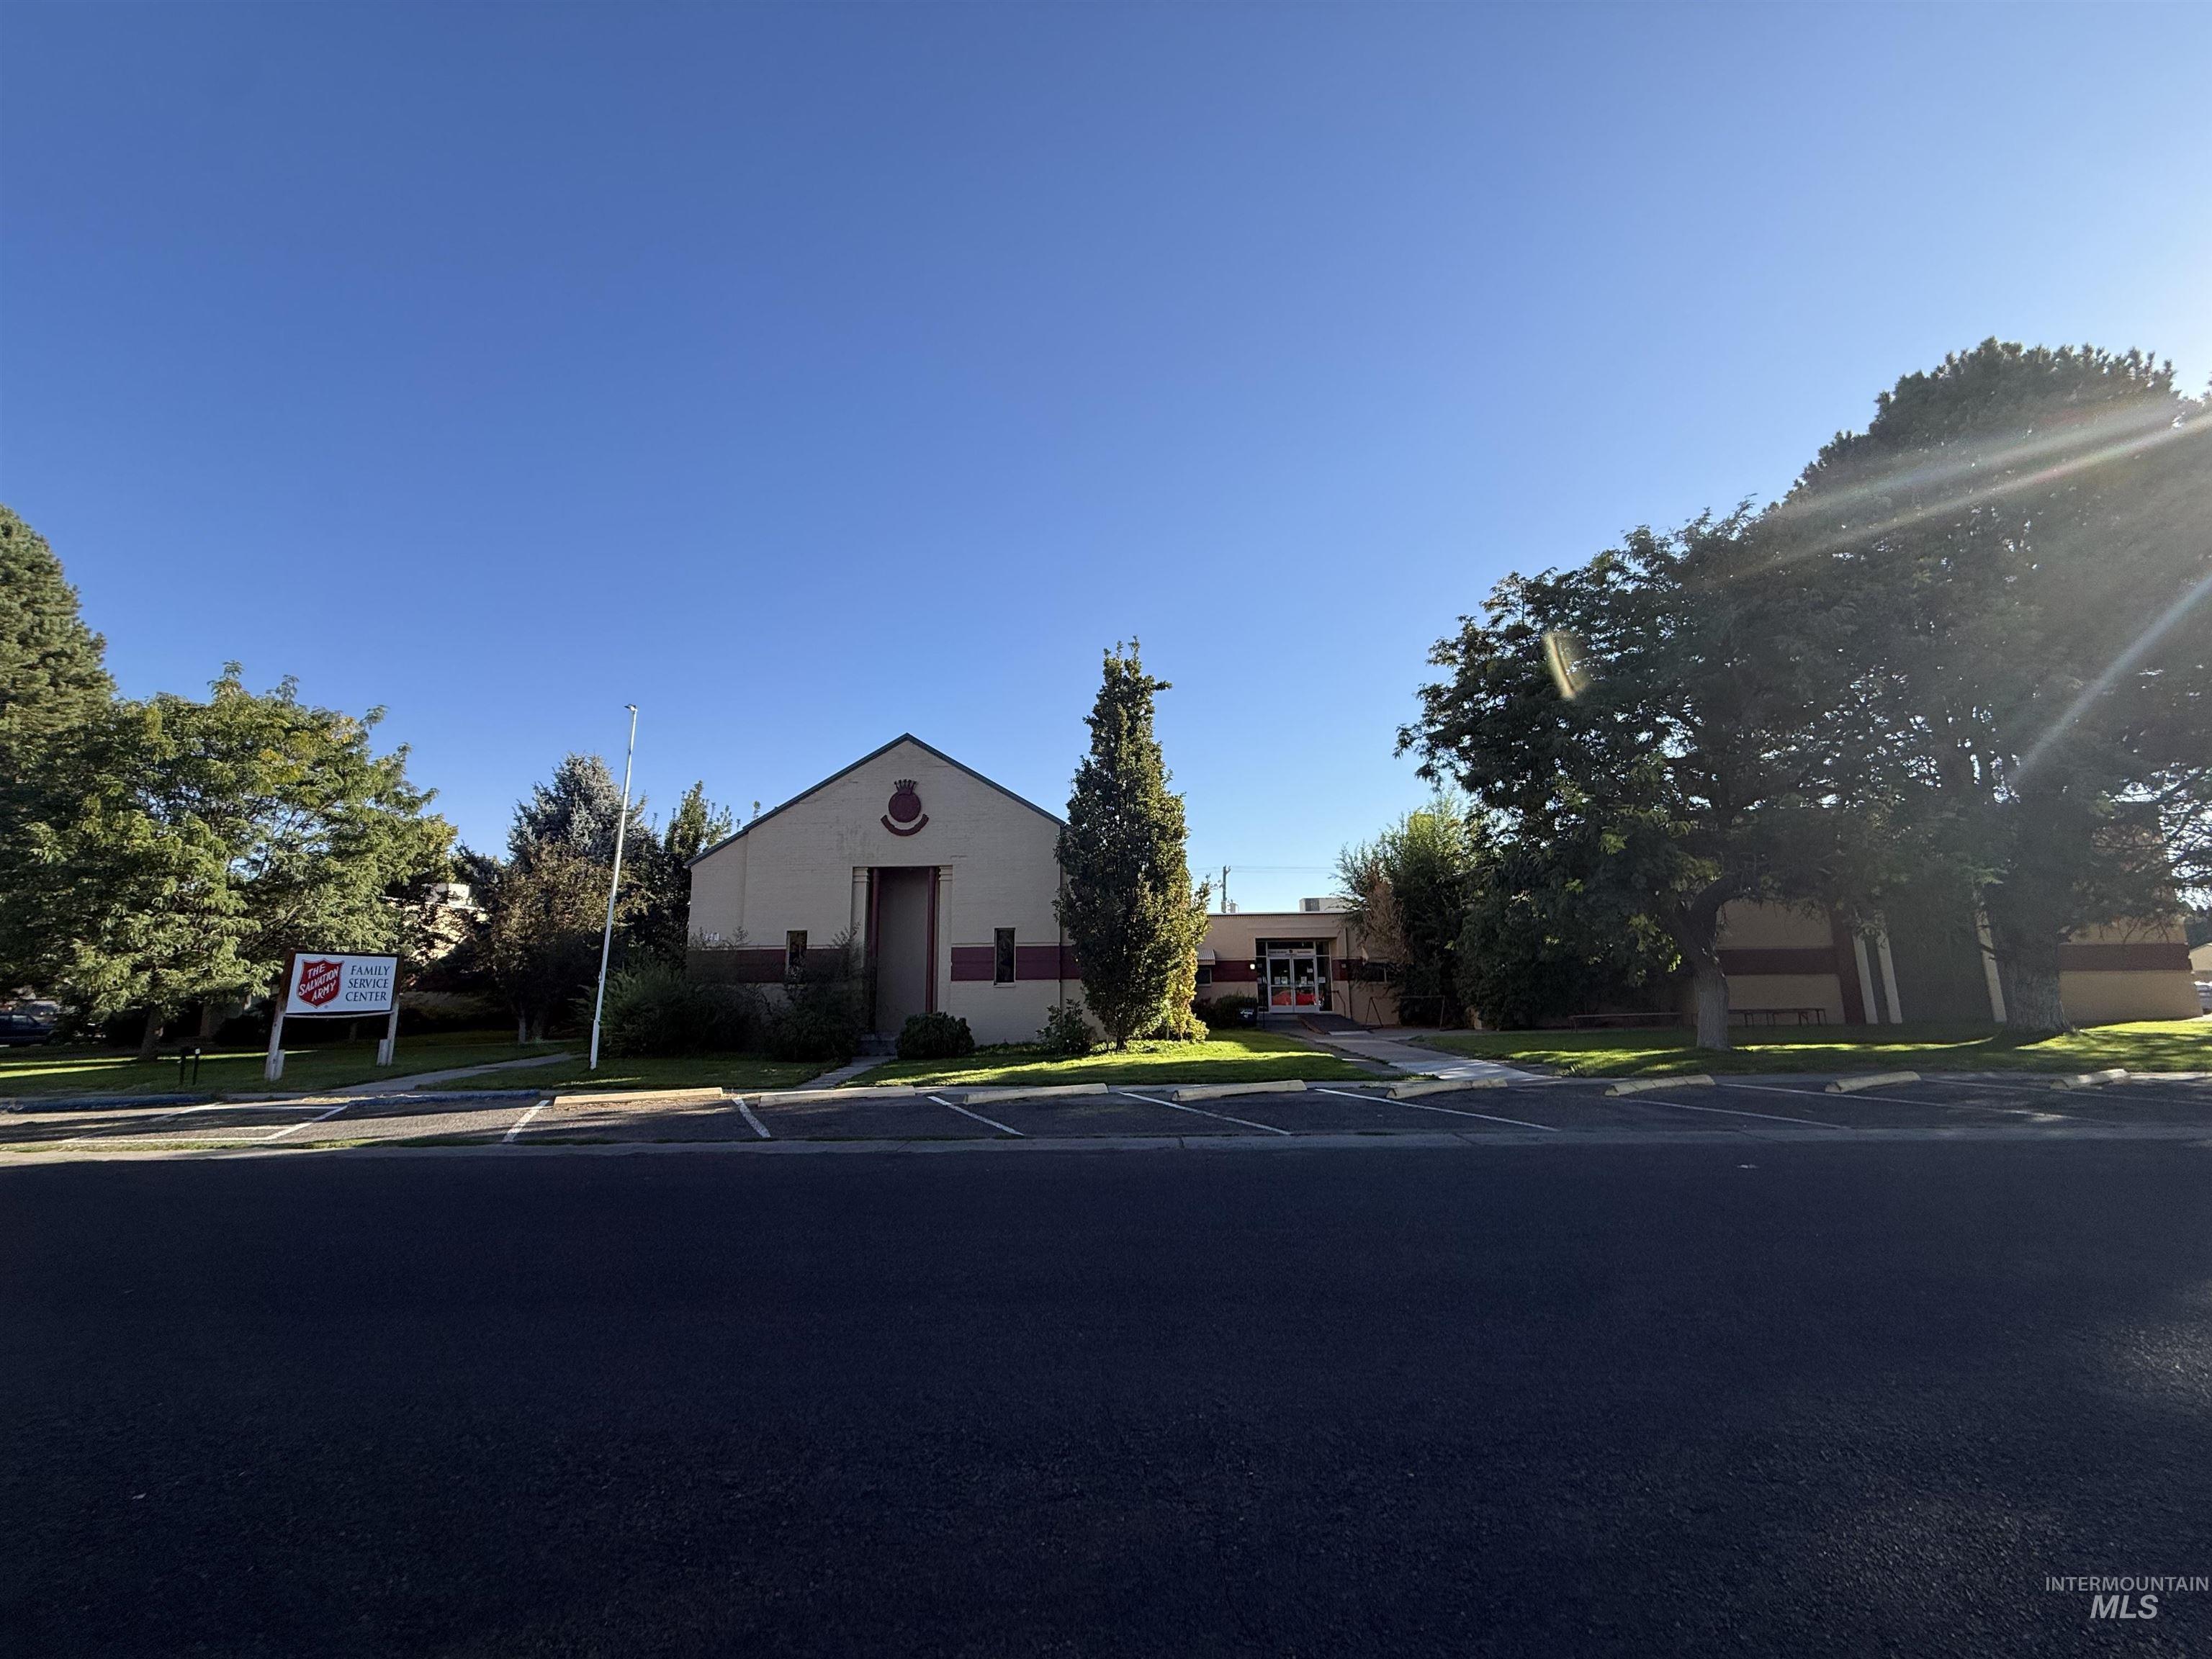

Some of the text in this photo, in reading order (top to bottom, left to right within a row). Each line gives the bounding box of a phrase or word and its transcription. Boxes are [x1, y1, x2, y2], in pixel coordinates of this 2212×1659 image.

[307, 963, 325, 979] THE
[351, 965, 390, 976] FAMILY
[298, 966, 339, 996] SALVATION
[348, 978, 389, 988] SERVICE
[311, 979, 336, 1002] ARMY
[346, 991, 387, 1002] CENTER
